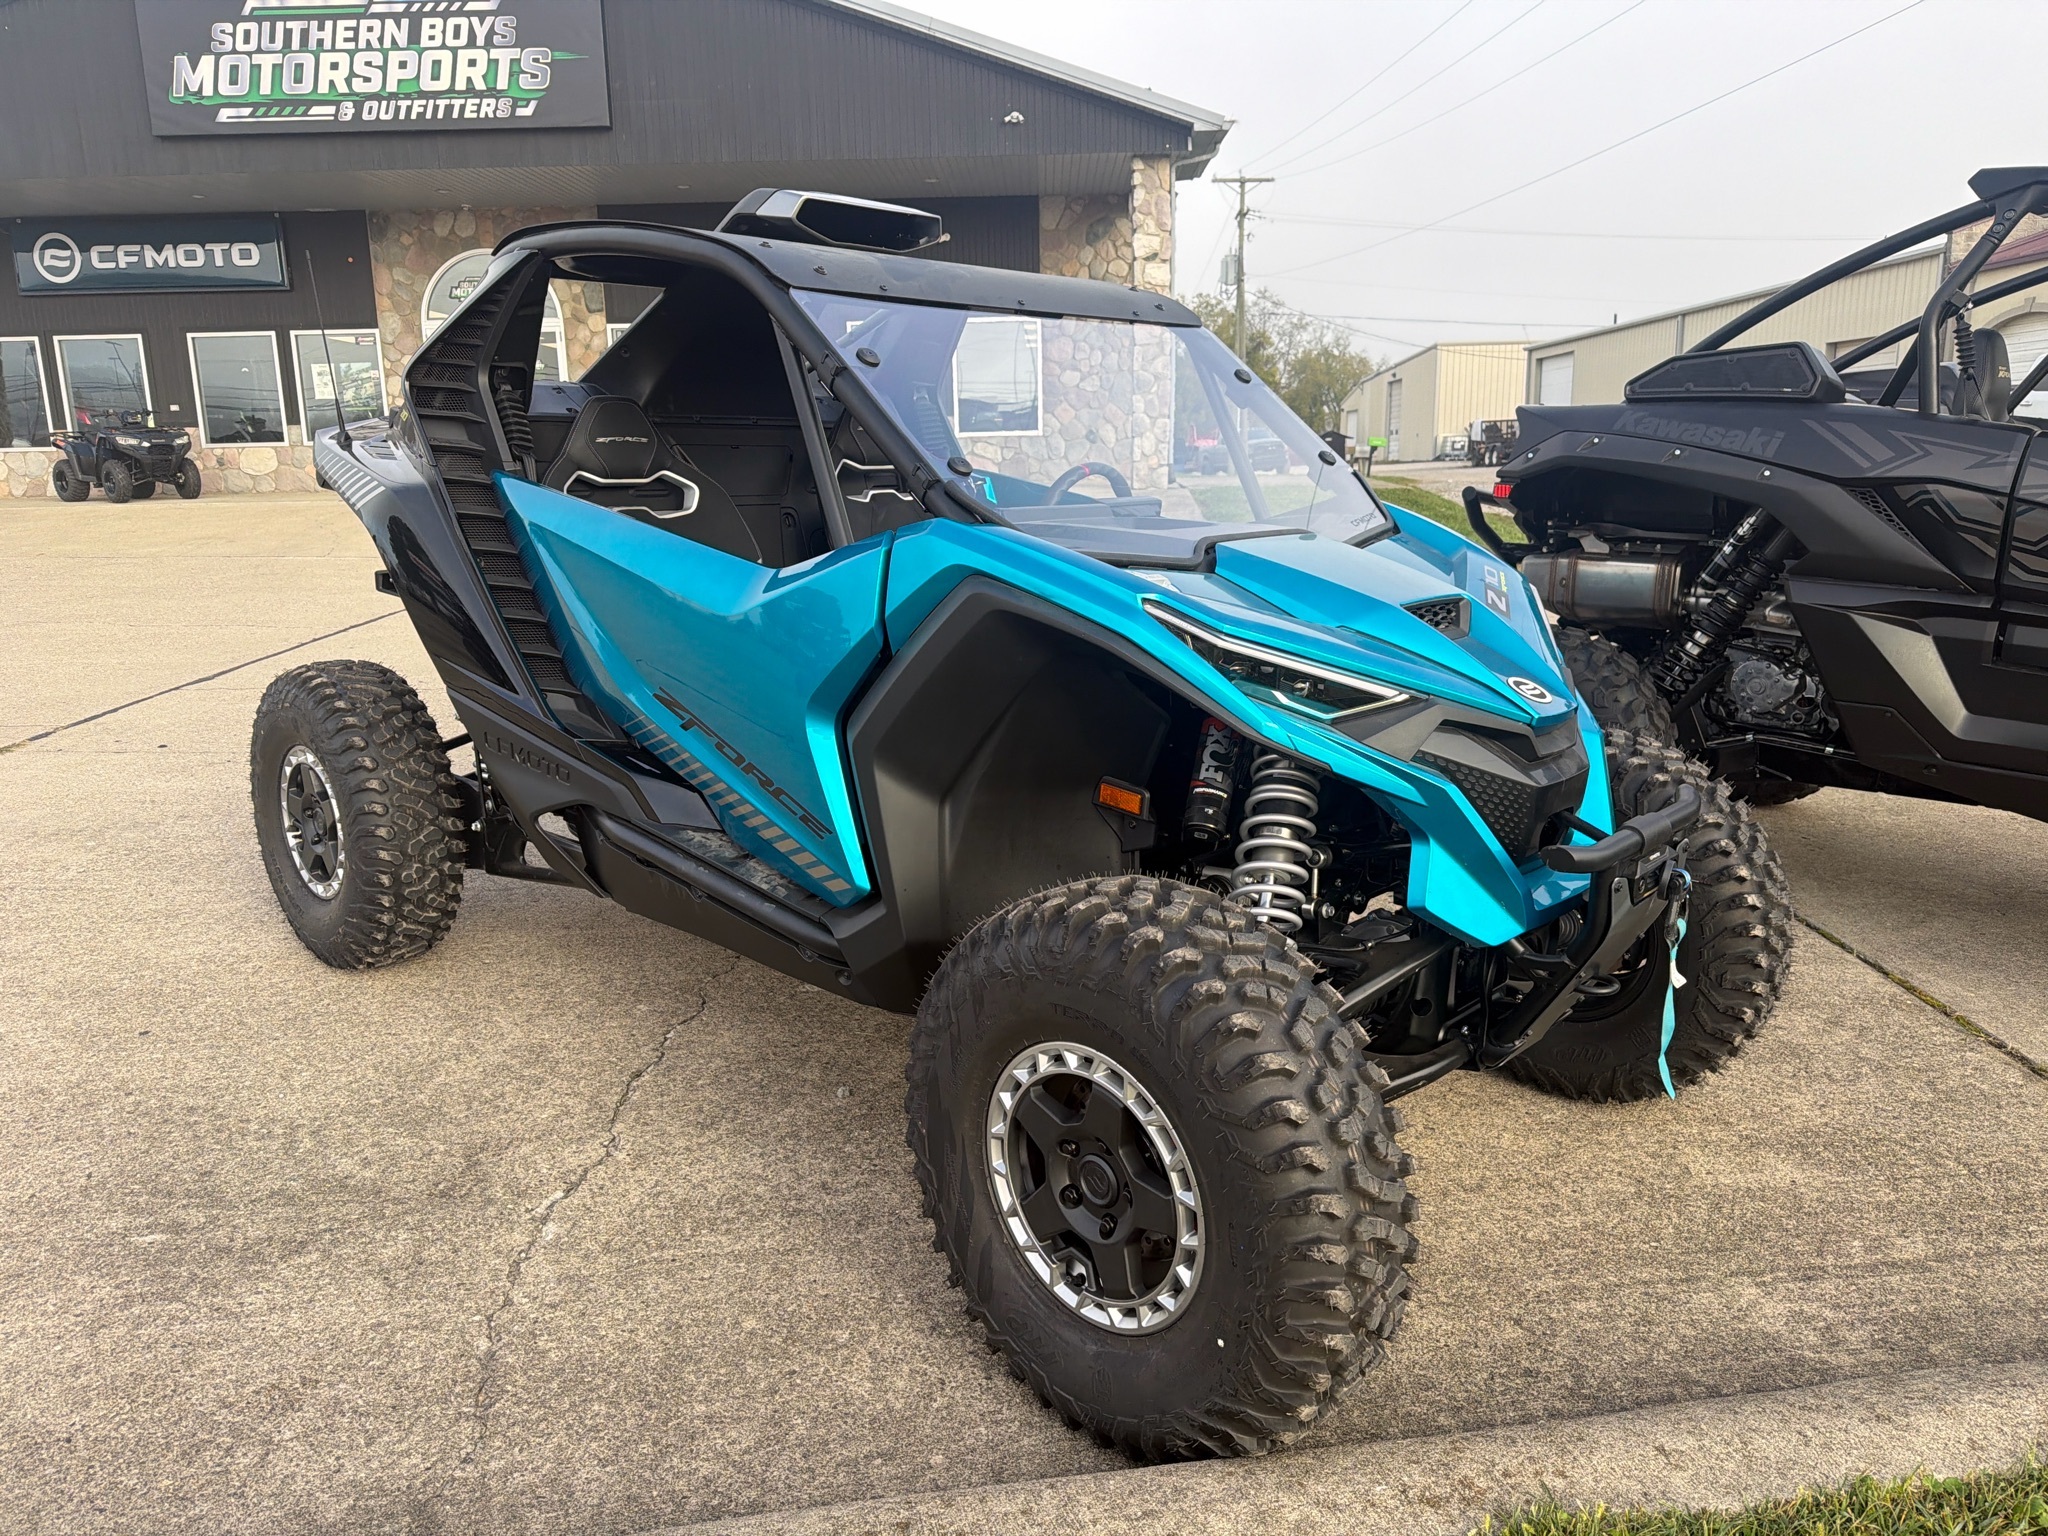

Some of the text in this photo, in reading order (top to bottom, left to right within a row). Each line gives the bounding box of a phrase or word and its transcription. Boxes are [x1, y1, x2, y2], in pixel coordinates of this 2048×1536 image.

[210, 15, 518, 53] SOUTHERN BOYS
[173, 47, 552, 97] MOTORSPORTS
[338, 98, 513, 121] & OUTFITTERS
[90, 242, 260, 269] CFMOTO
[1612, 410, 1786, 458] Kawasaki
[652, 686, 834, 841] ZFORCE
